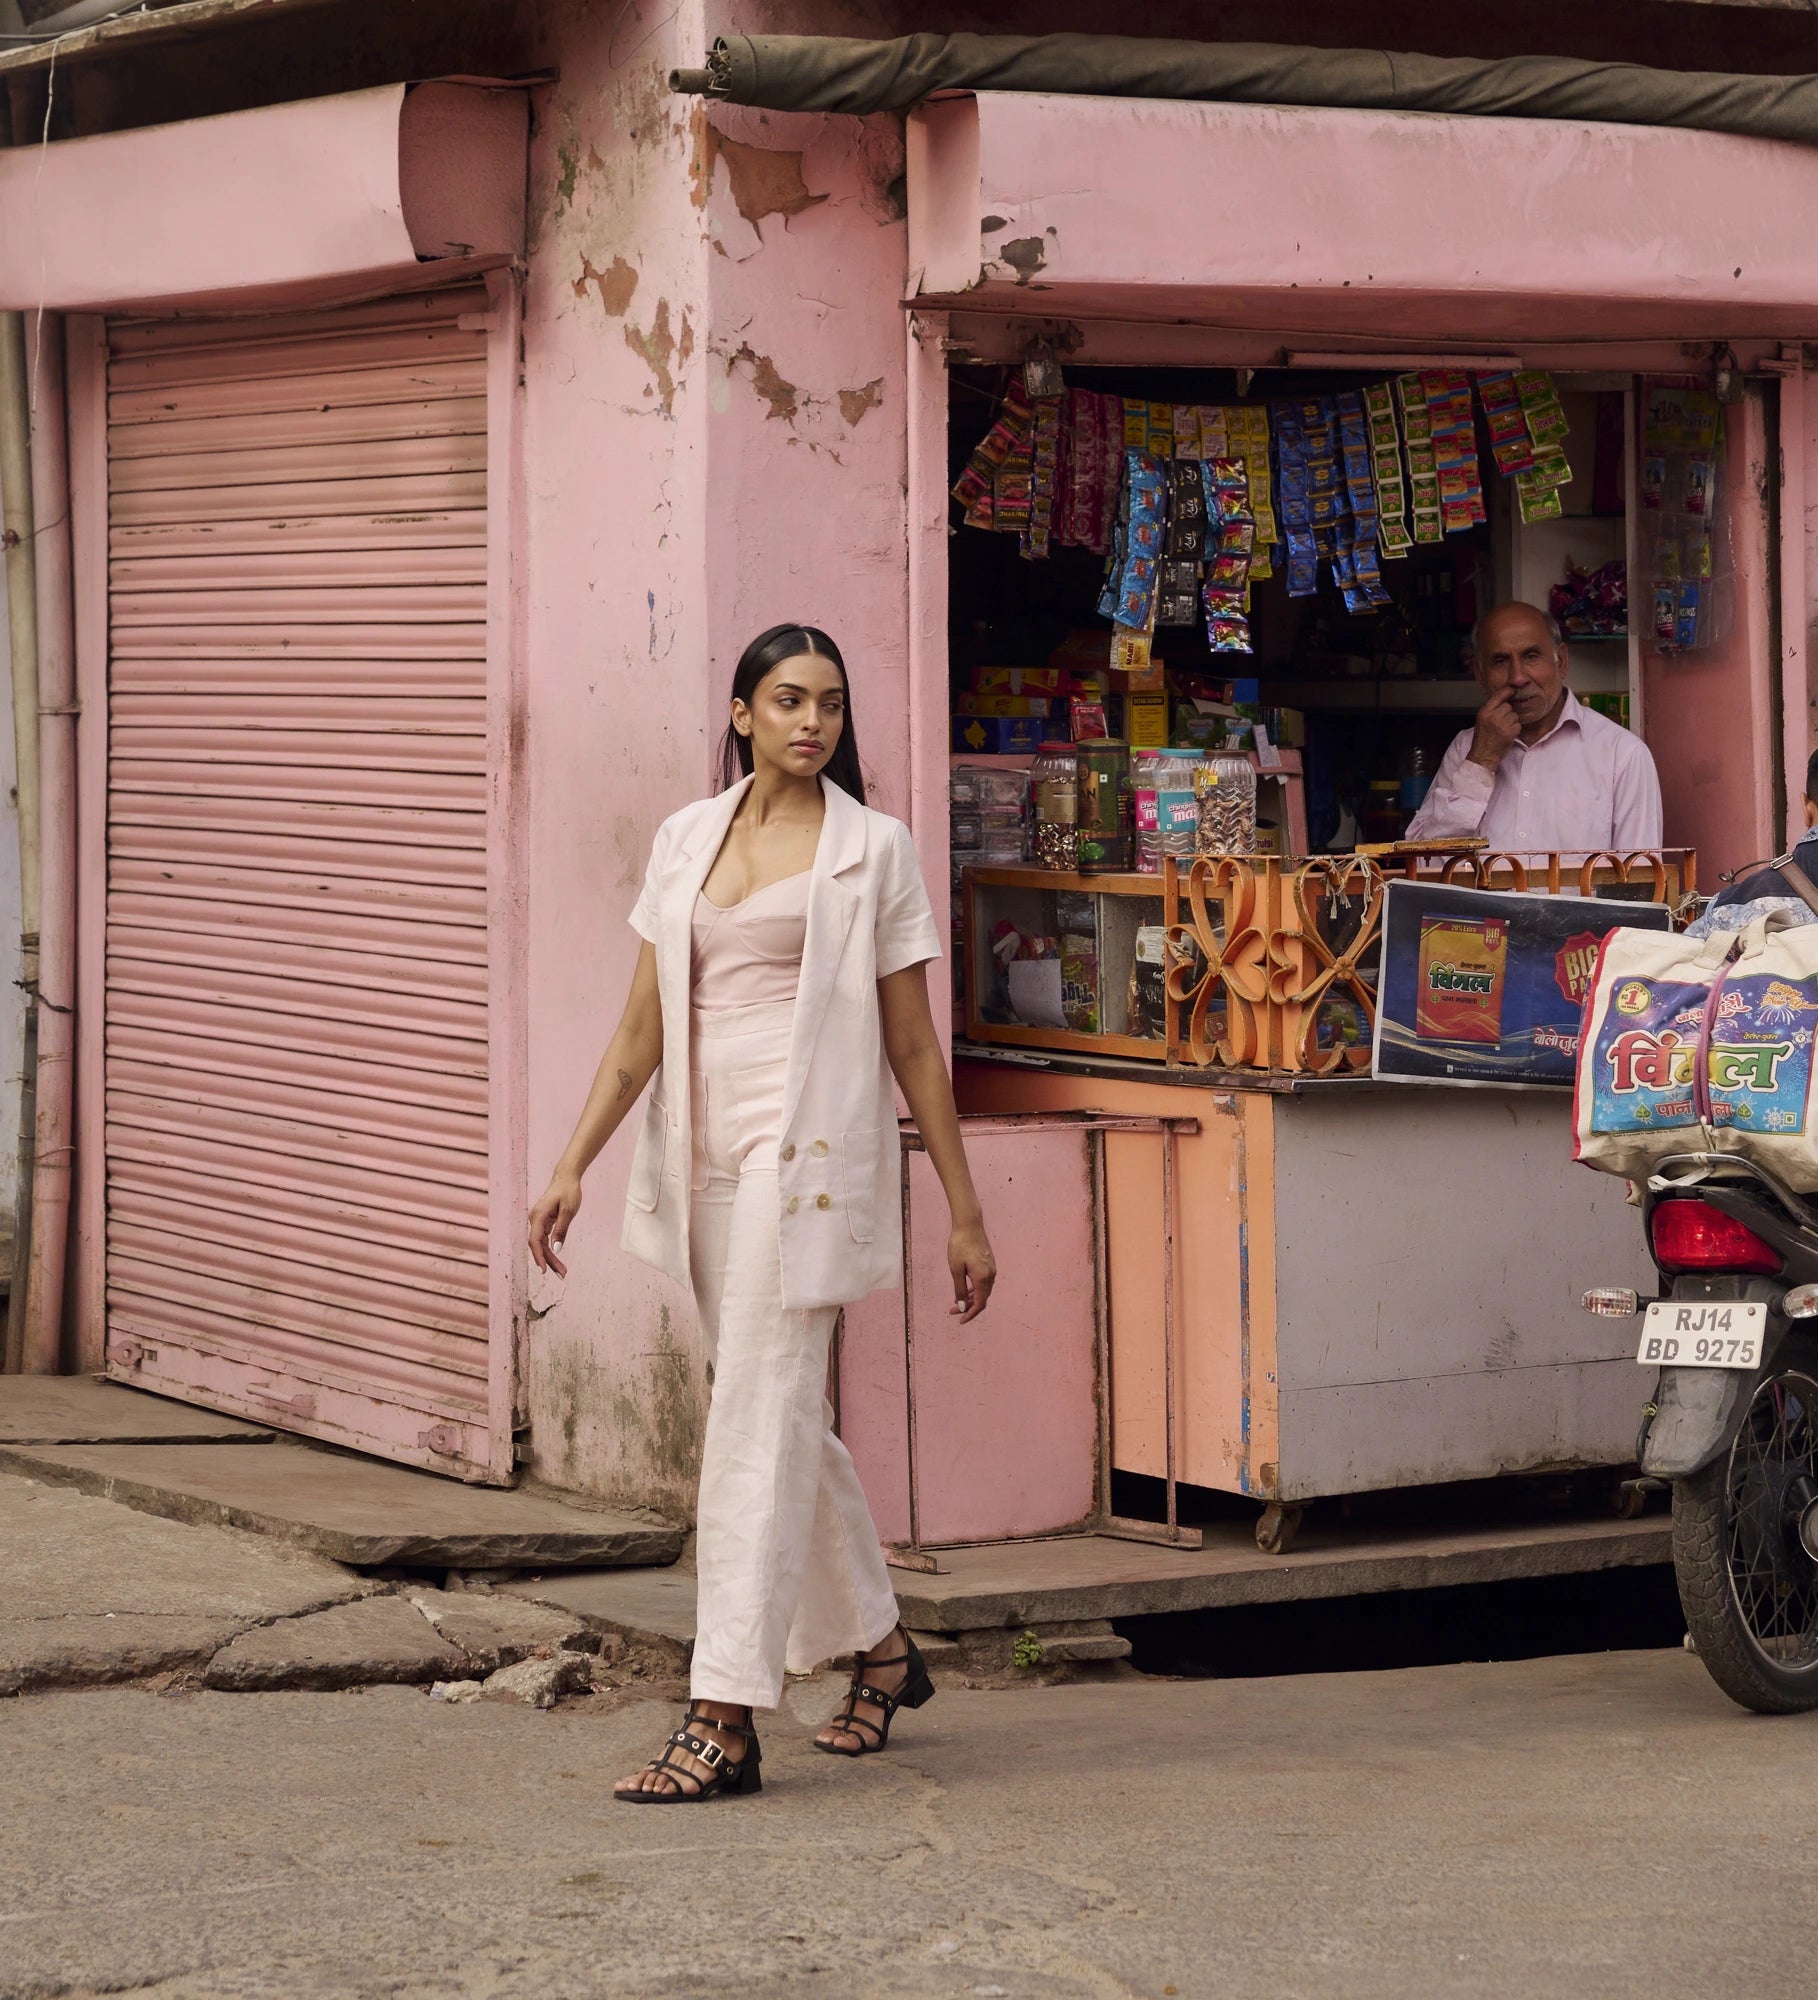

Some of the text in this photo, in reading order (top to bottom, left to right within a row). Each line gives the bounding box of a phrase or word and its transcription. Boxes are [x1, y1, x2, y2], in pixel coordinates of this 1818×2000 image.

[1485, 928, 1500, 939] BIG
[1563, 944, 1599, 980] BIG
[1627, 989, 1638, 1006] 1
[1656, 1101, 1692, 1118] पान
[1675, 1308, 1732, 1332] RJ14
[1645, 1338, 1755, 1363] BD 9275
